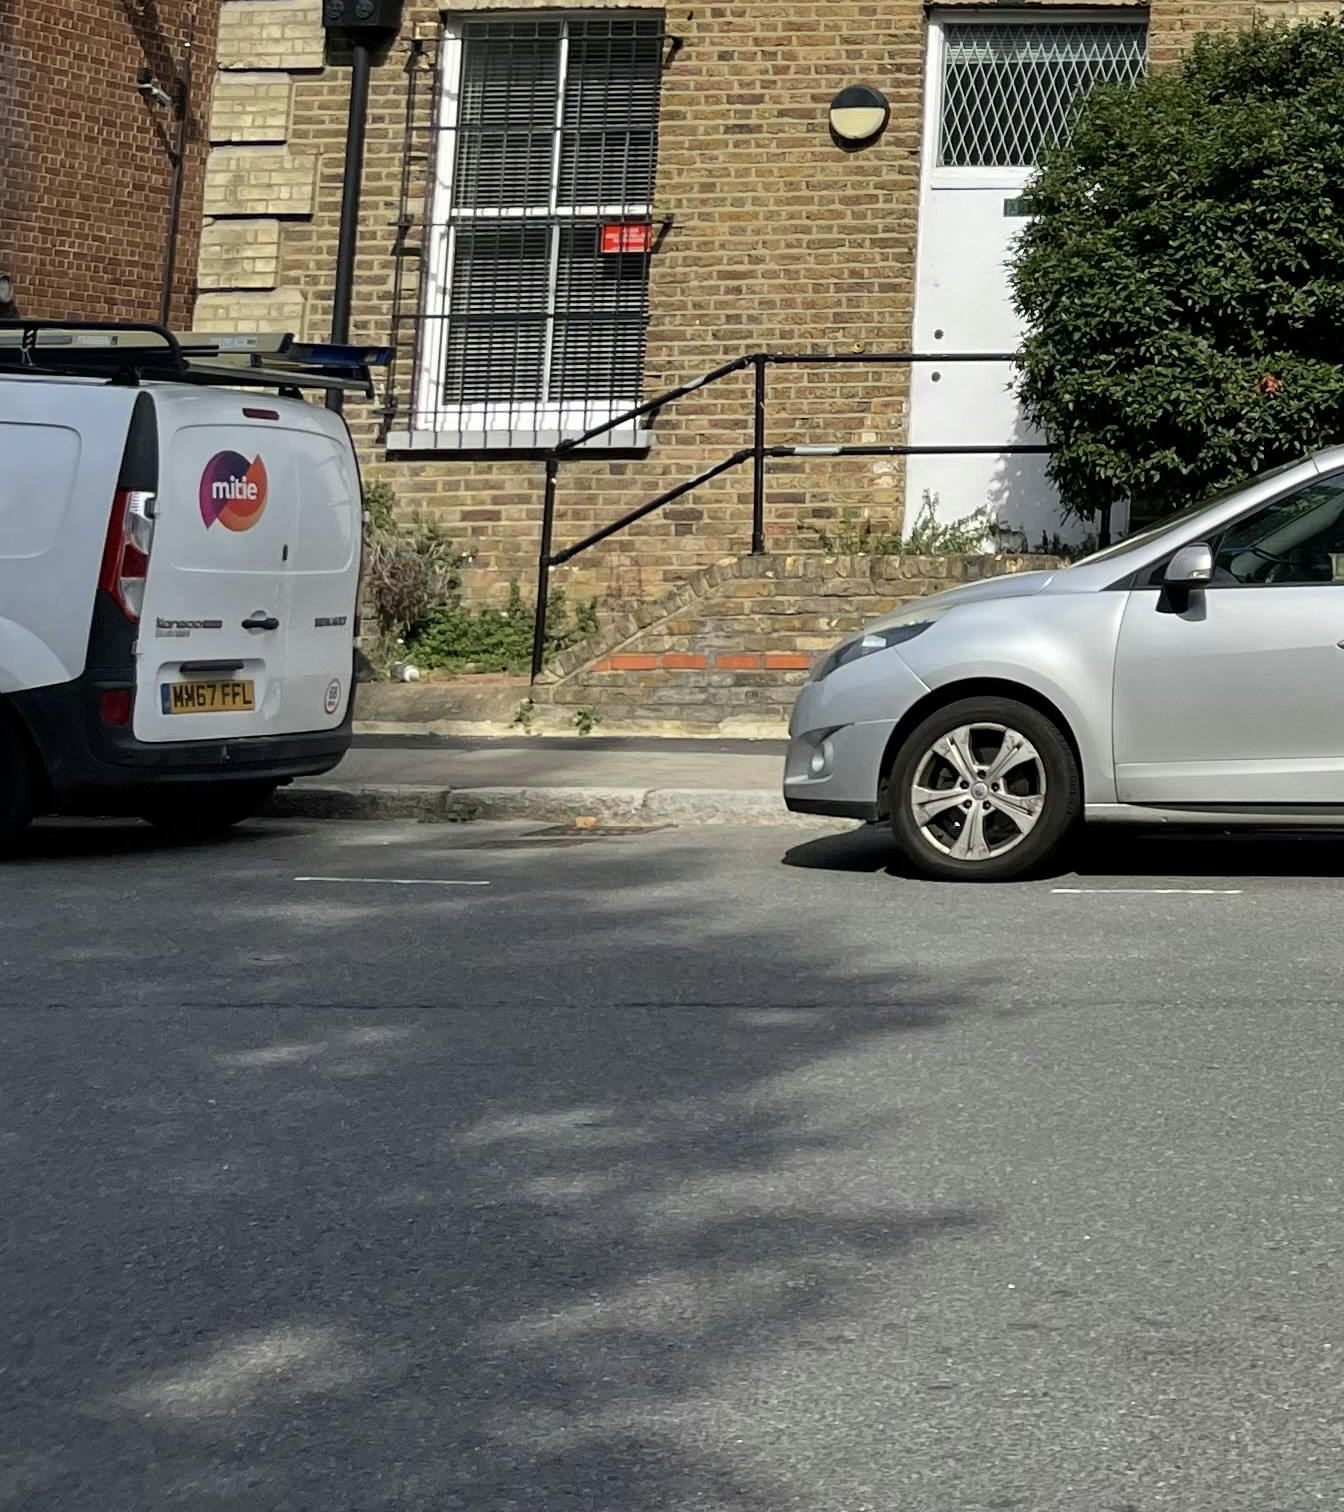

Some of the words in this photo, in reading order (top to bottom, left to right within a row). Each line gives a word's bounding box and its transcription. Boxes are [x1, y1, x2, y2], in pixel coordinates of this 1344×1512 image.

[212, 475, 258, 500] mitie
[172, 684, 217, 708] MM67
[220, 683, 253, 706] FFL
